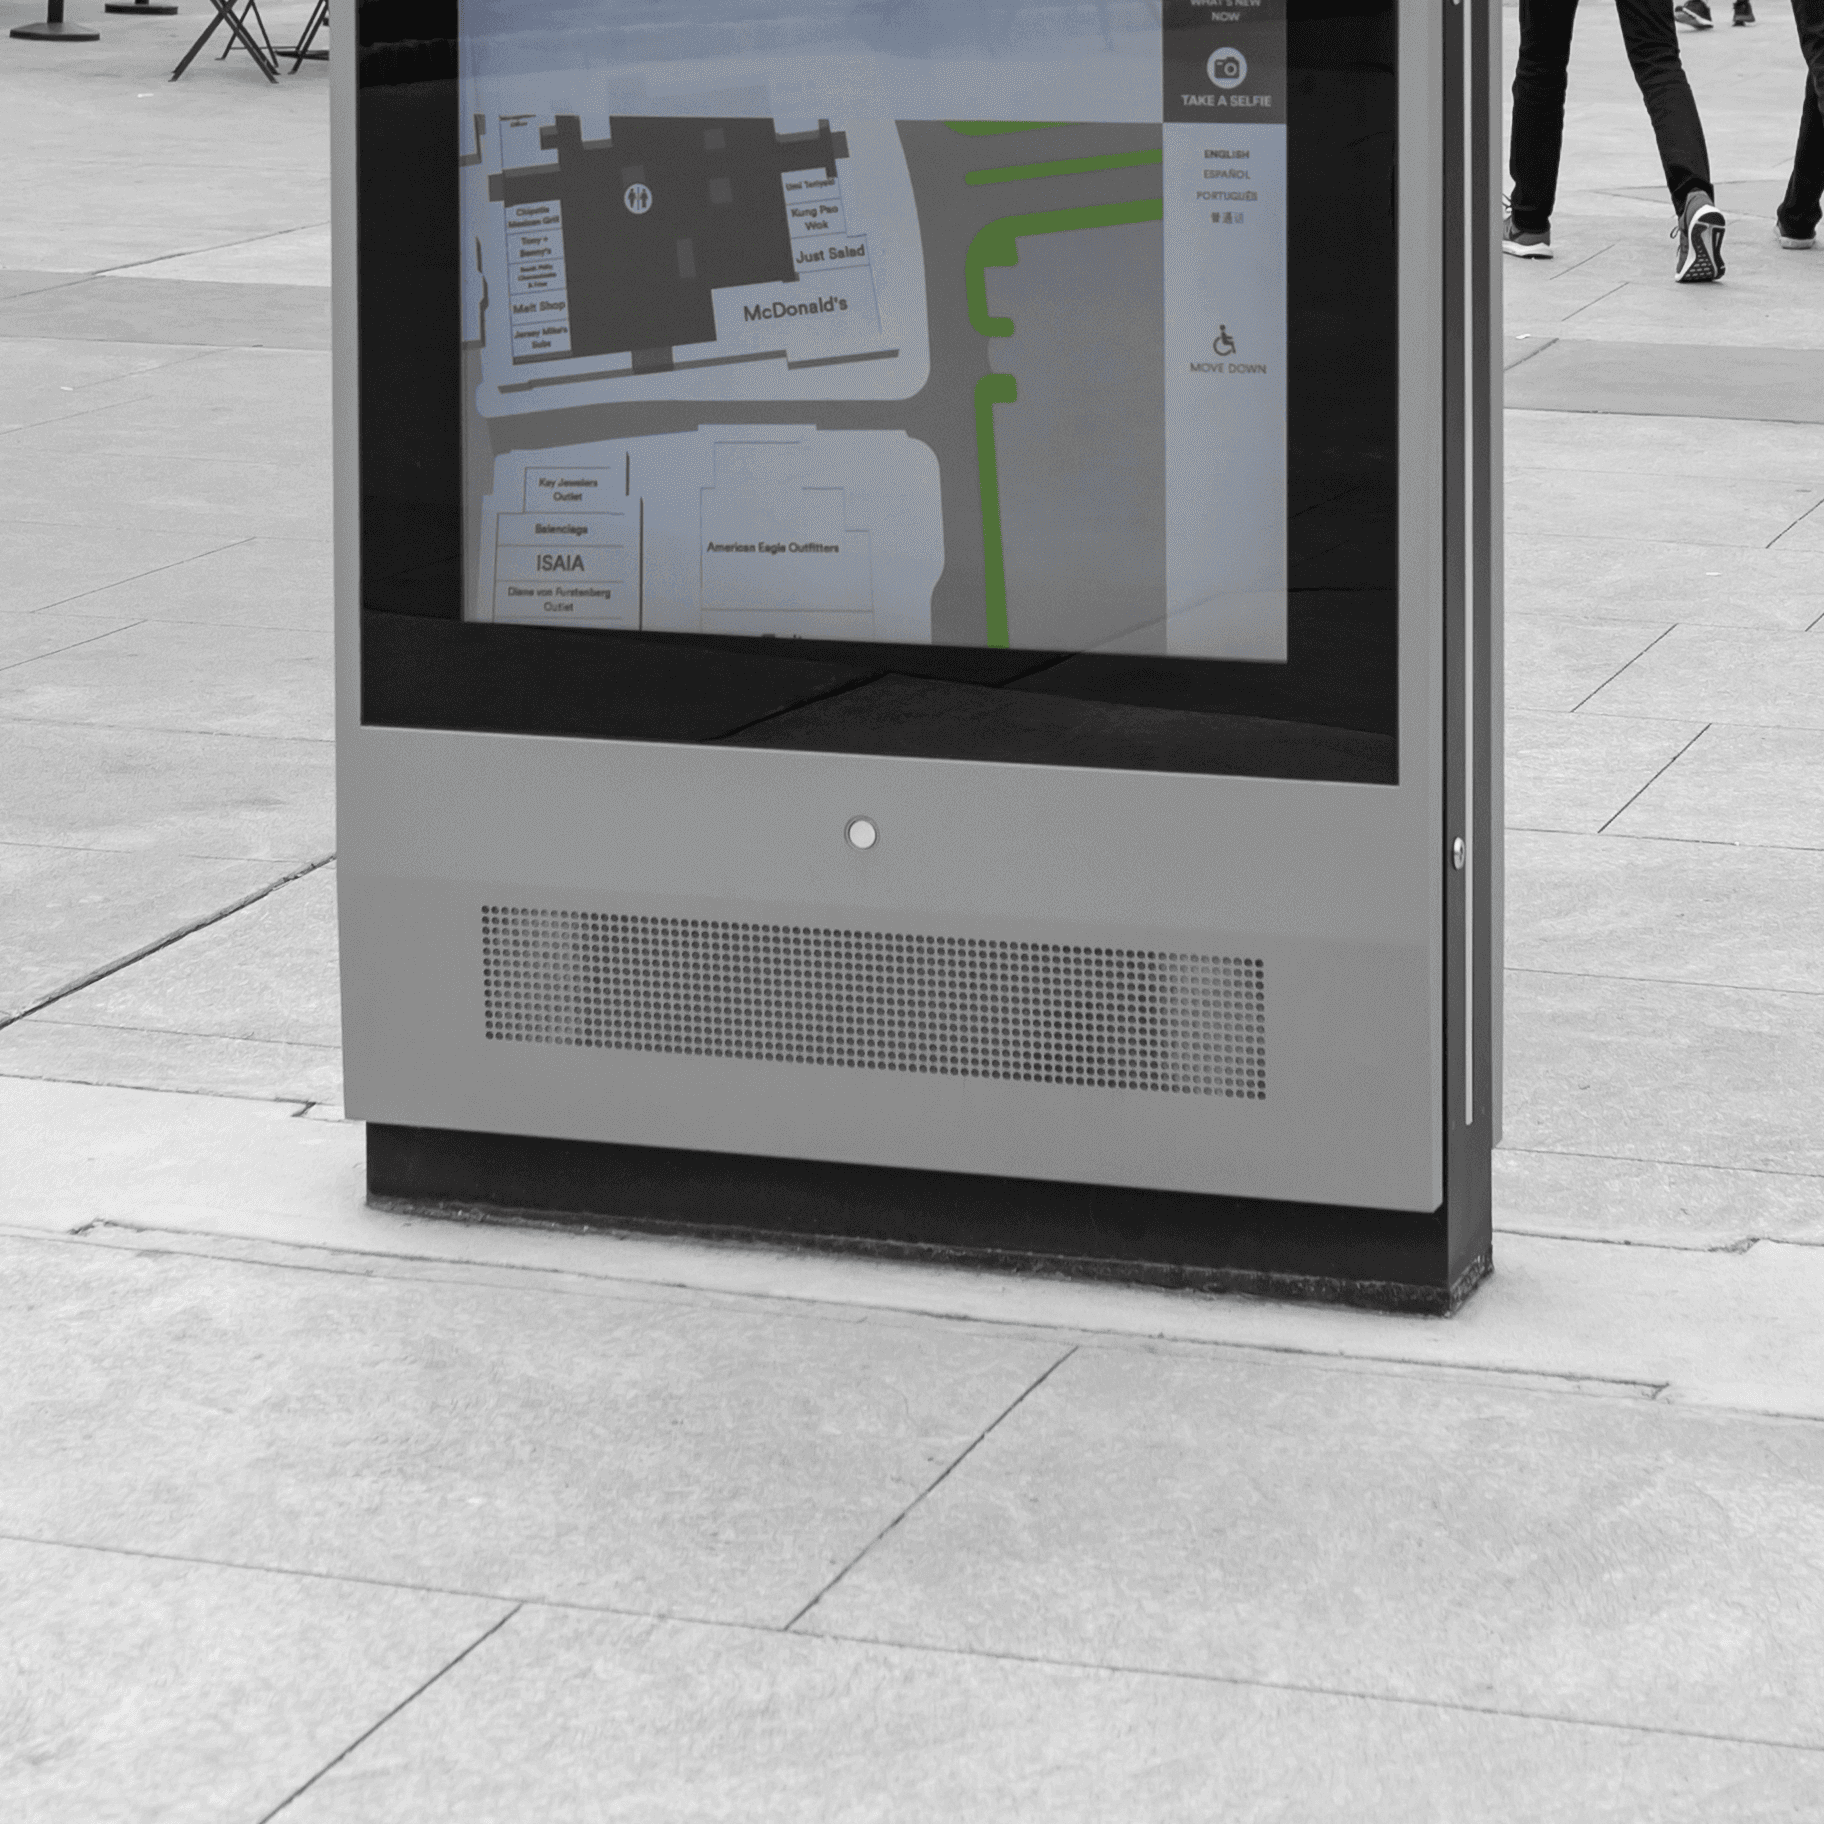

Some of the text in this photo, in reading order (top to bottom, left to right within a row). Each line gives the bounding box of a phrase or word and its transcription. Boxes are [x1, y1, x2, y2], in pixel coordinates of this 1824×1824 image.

[1211, 11, 1241, 22] NOW
[1181, 94, 1272, 107] TAKE A SELFIE
[1204, 149, 1250, 160] ENGLISH
[1203, 168, 1251, 180] ESPAÑOL
[796, 244, 866, 264] Just Salad
[743, 295, 849, 322] McDonald's
[1190, 363, 1267, 375] MOVE DOWN
[553, 492, 583, 502] Outlet
[707, 541, 840, 556] American Eagle Outfitters
[536, 554, 585, 572] ISAIA
[543, 601, 574, 612] Outlet
